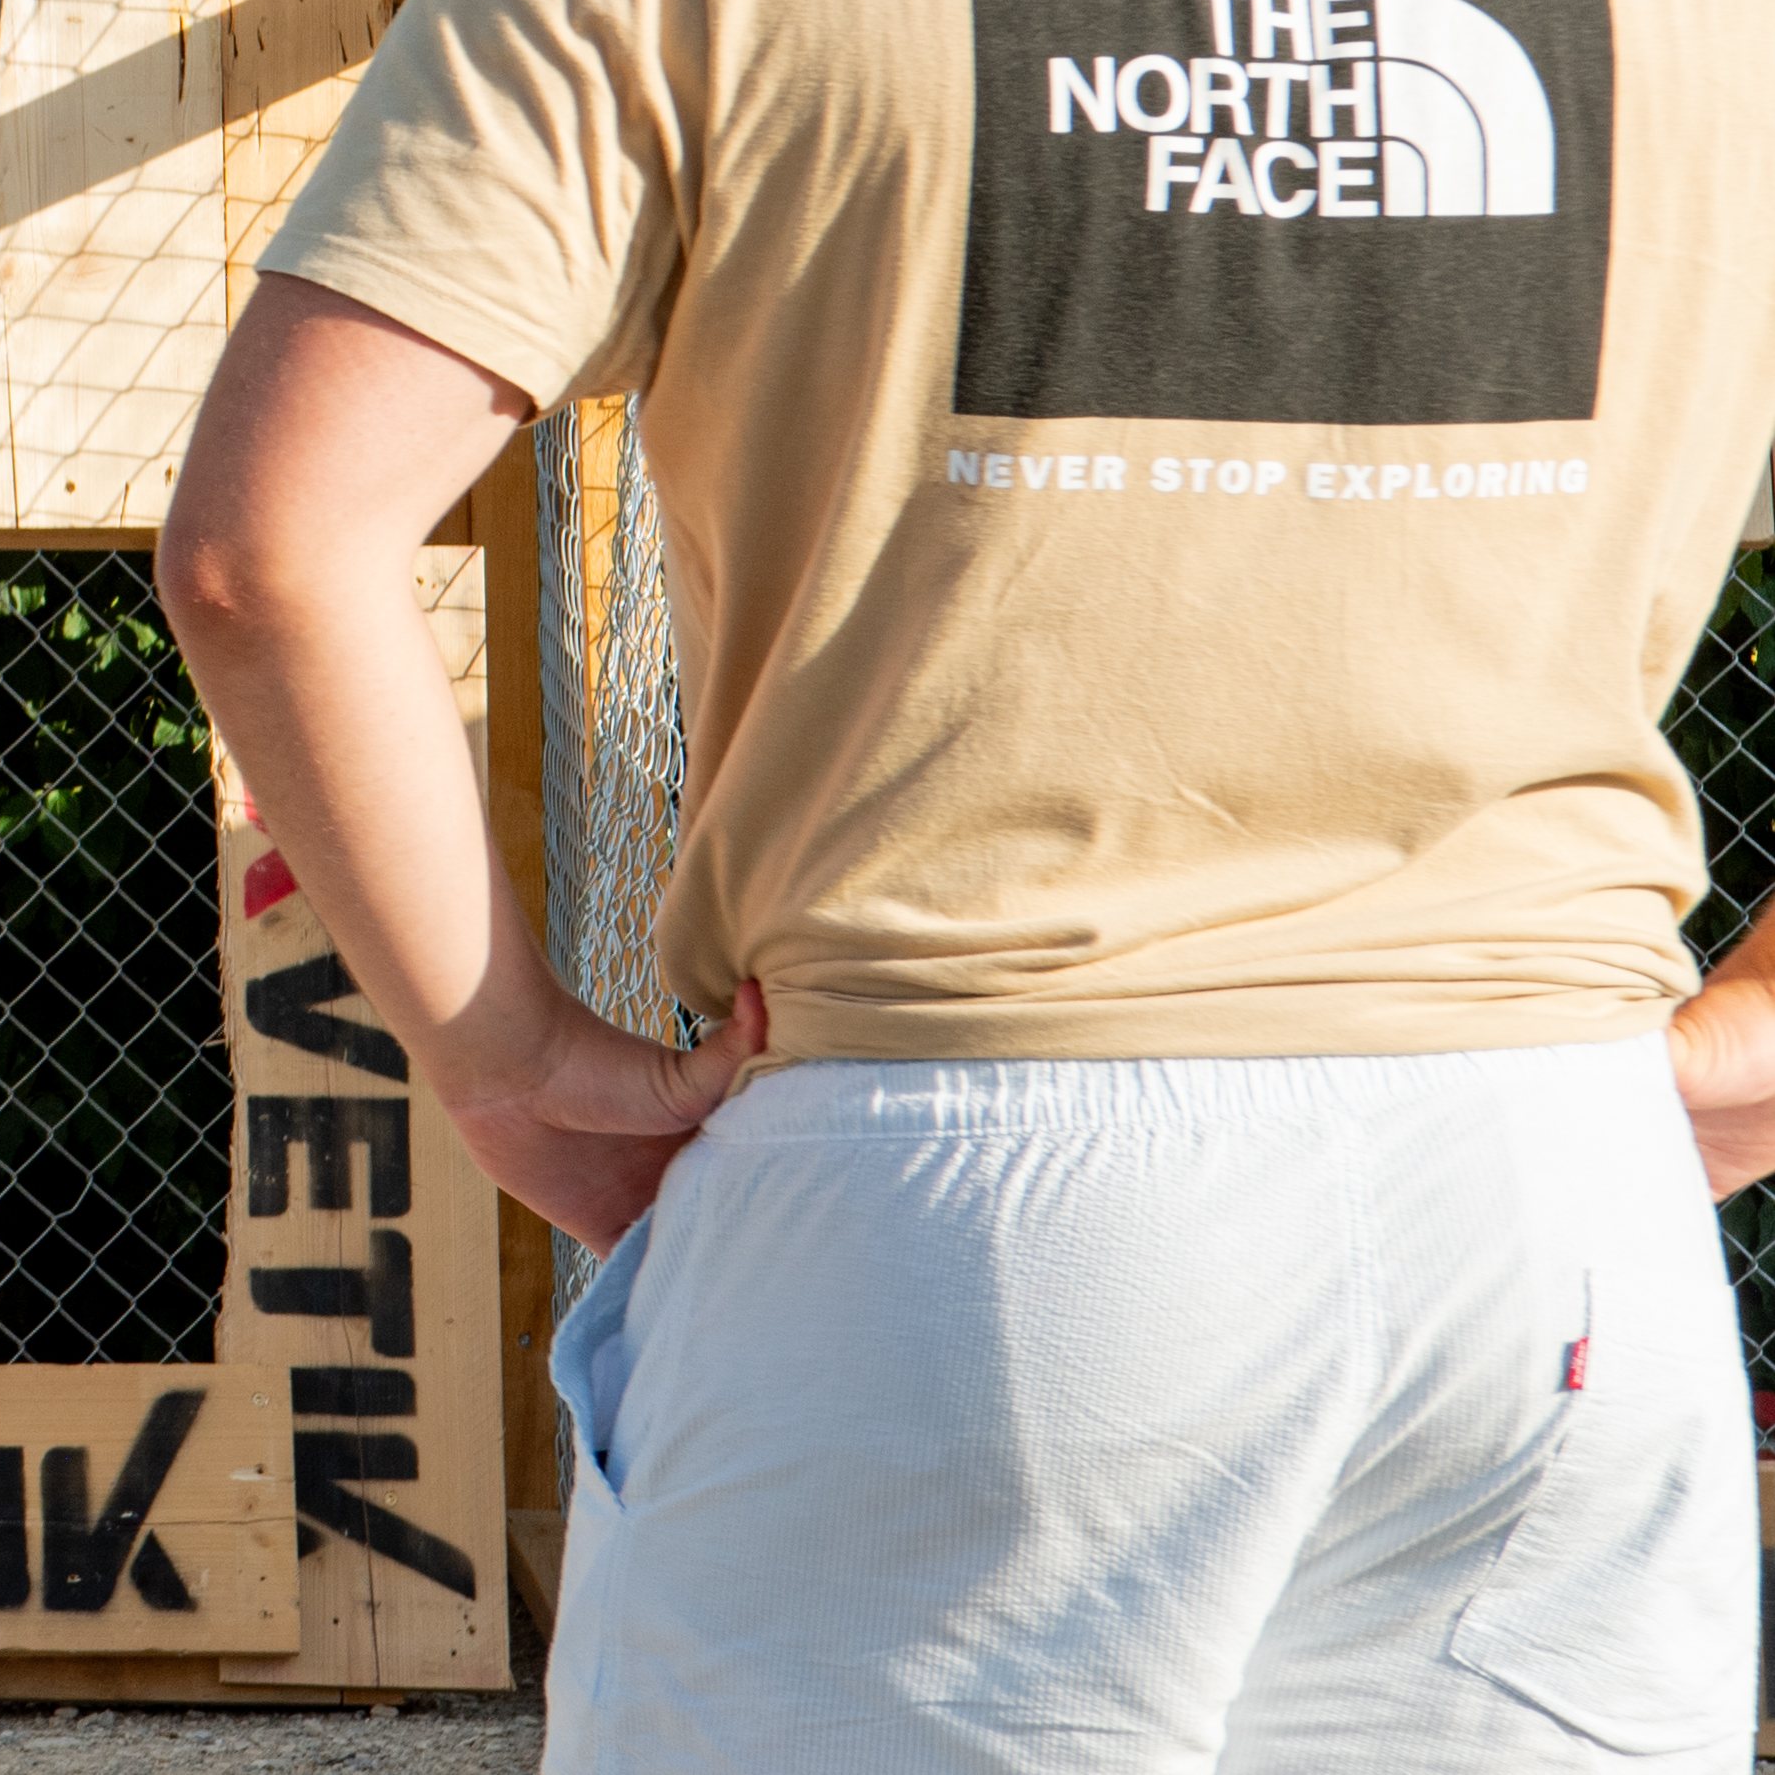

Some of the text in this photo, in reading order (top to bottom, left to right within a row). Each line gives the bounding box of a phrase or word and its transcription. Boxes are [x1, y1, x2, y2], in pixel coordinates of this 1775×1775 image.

[1048, 53, 1380, 139] NORTH
[1145, 135, 1380, 219] FACE
[946, 449, 1590, 501] NEVER STOP EXPLORING
